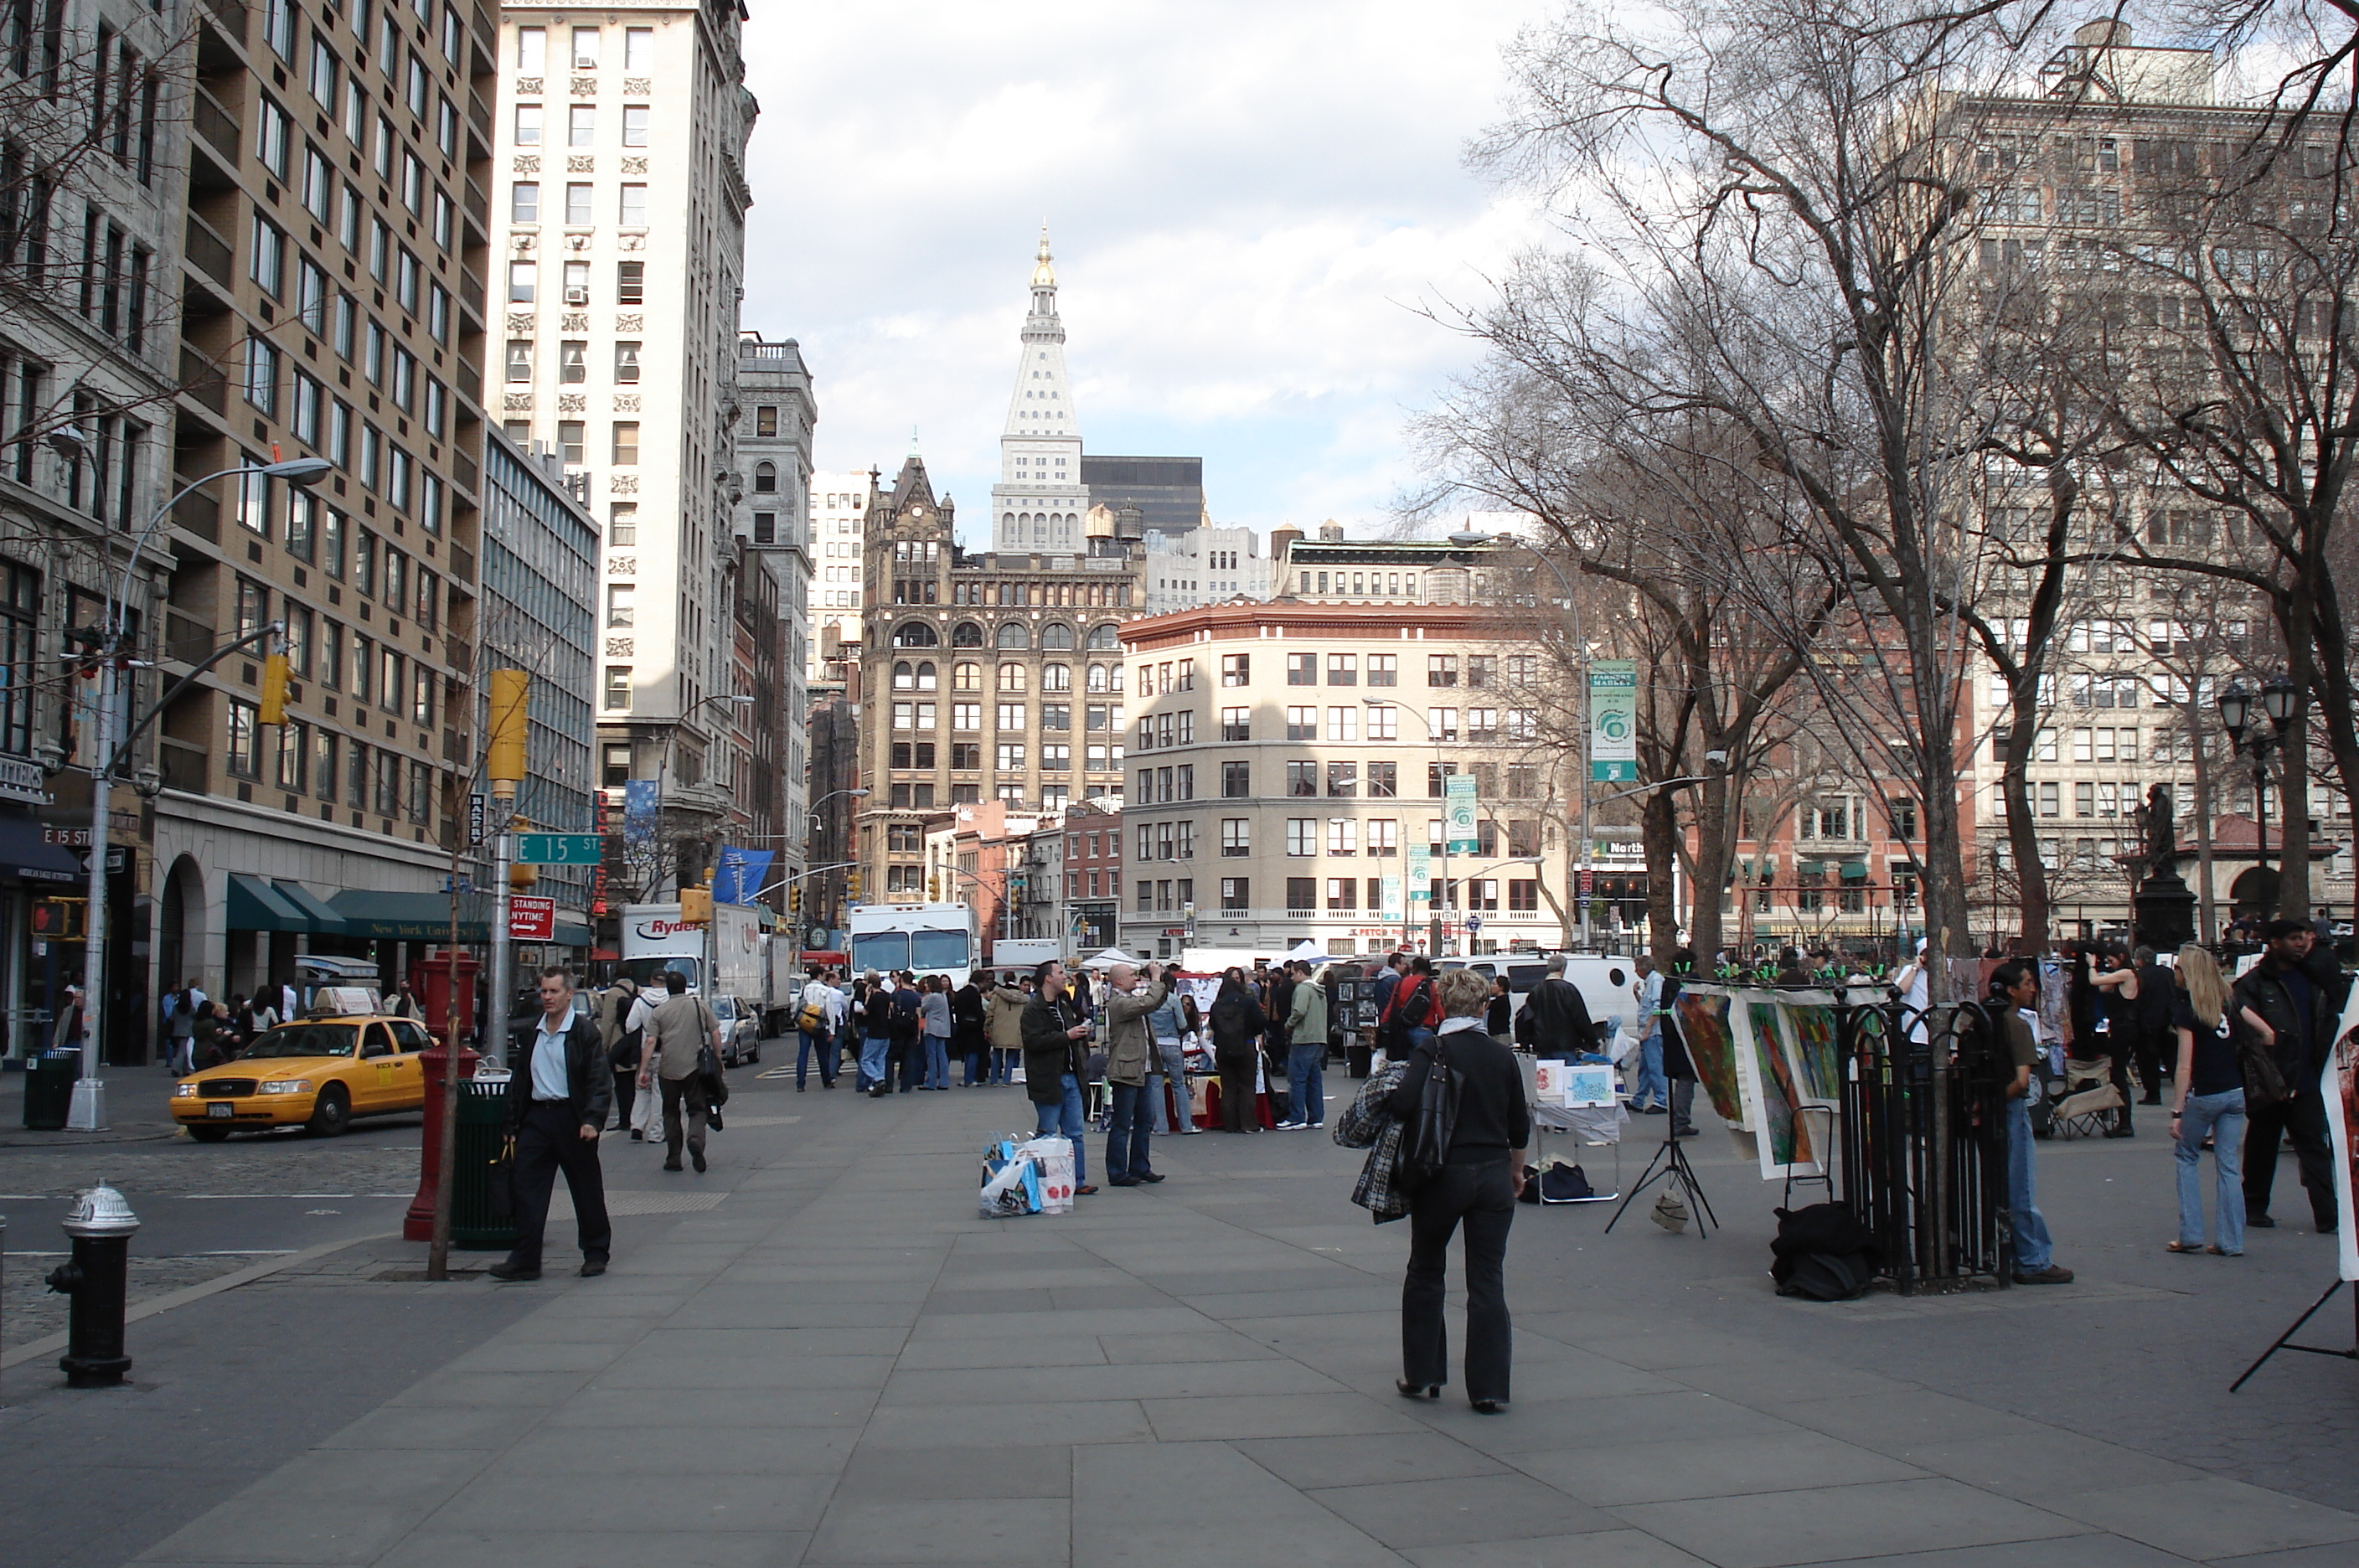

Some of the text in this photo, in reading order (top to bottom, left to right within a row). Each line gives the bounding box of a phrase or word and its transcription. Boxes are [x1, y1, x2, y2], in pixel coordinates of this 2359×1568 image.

[471, 797, 483, 844] BAKERY
[45, 829, 89, 843] E 15 ST
[519, 837, 597, 861] E 15 ST
[1610, 842, 1644, 853] North
[514, 899, 551, 910] STANDING
[510, 911, 545, 922] NYTIME
[372, 924, 480, 937] New York Univrsity
[1360, 928, 1388, 936] PETCO
